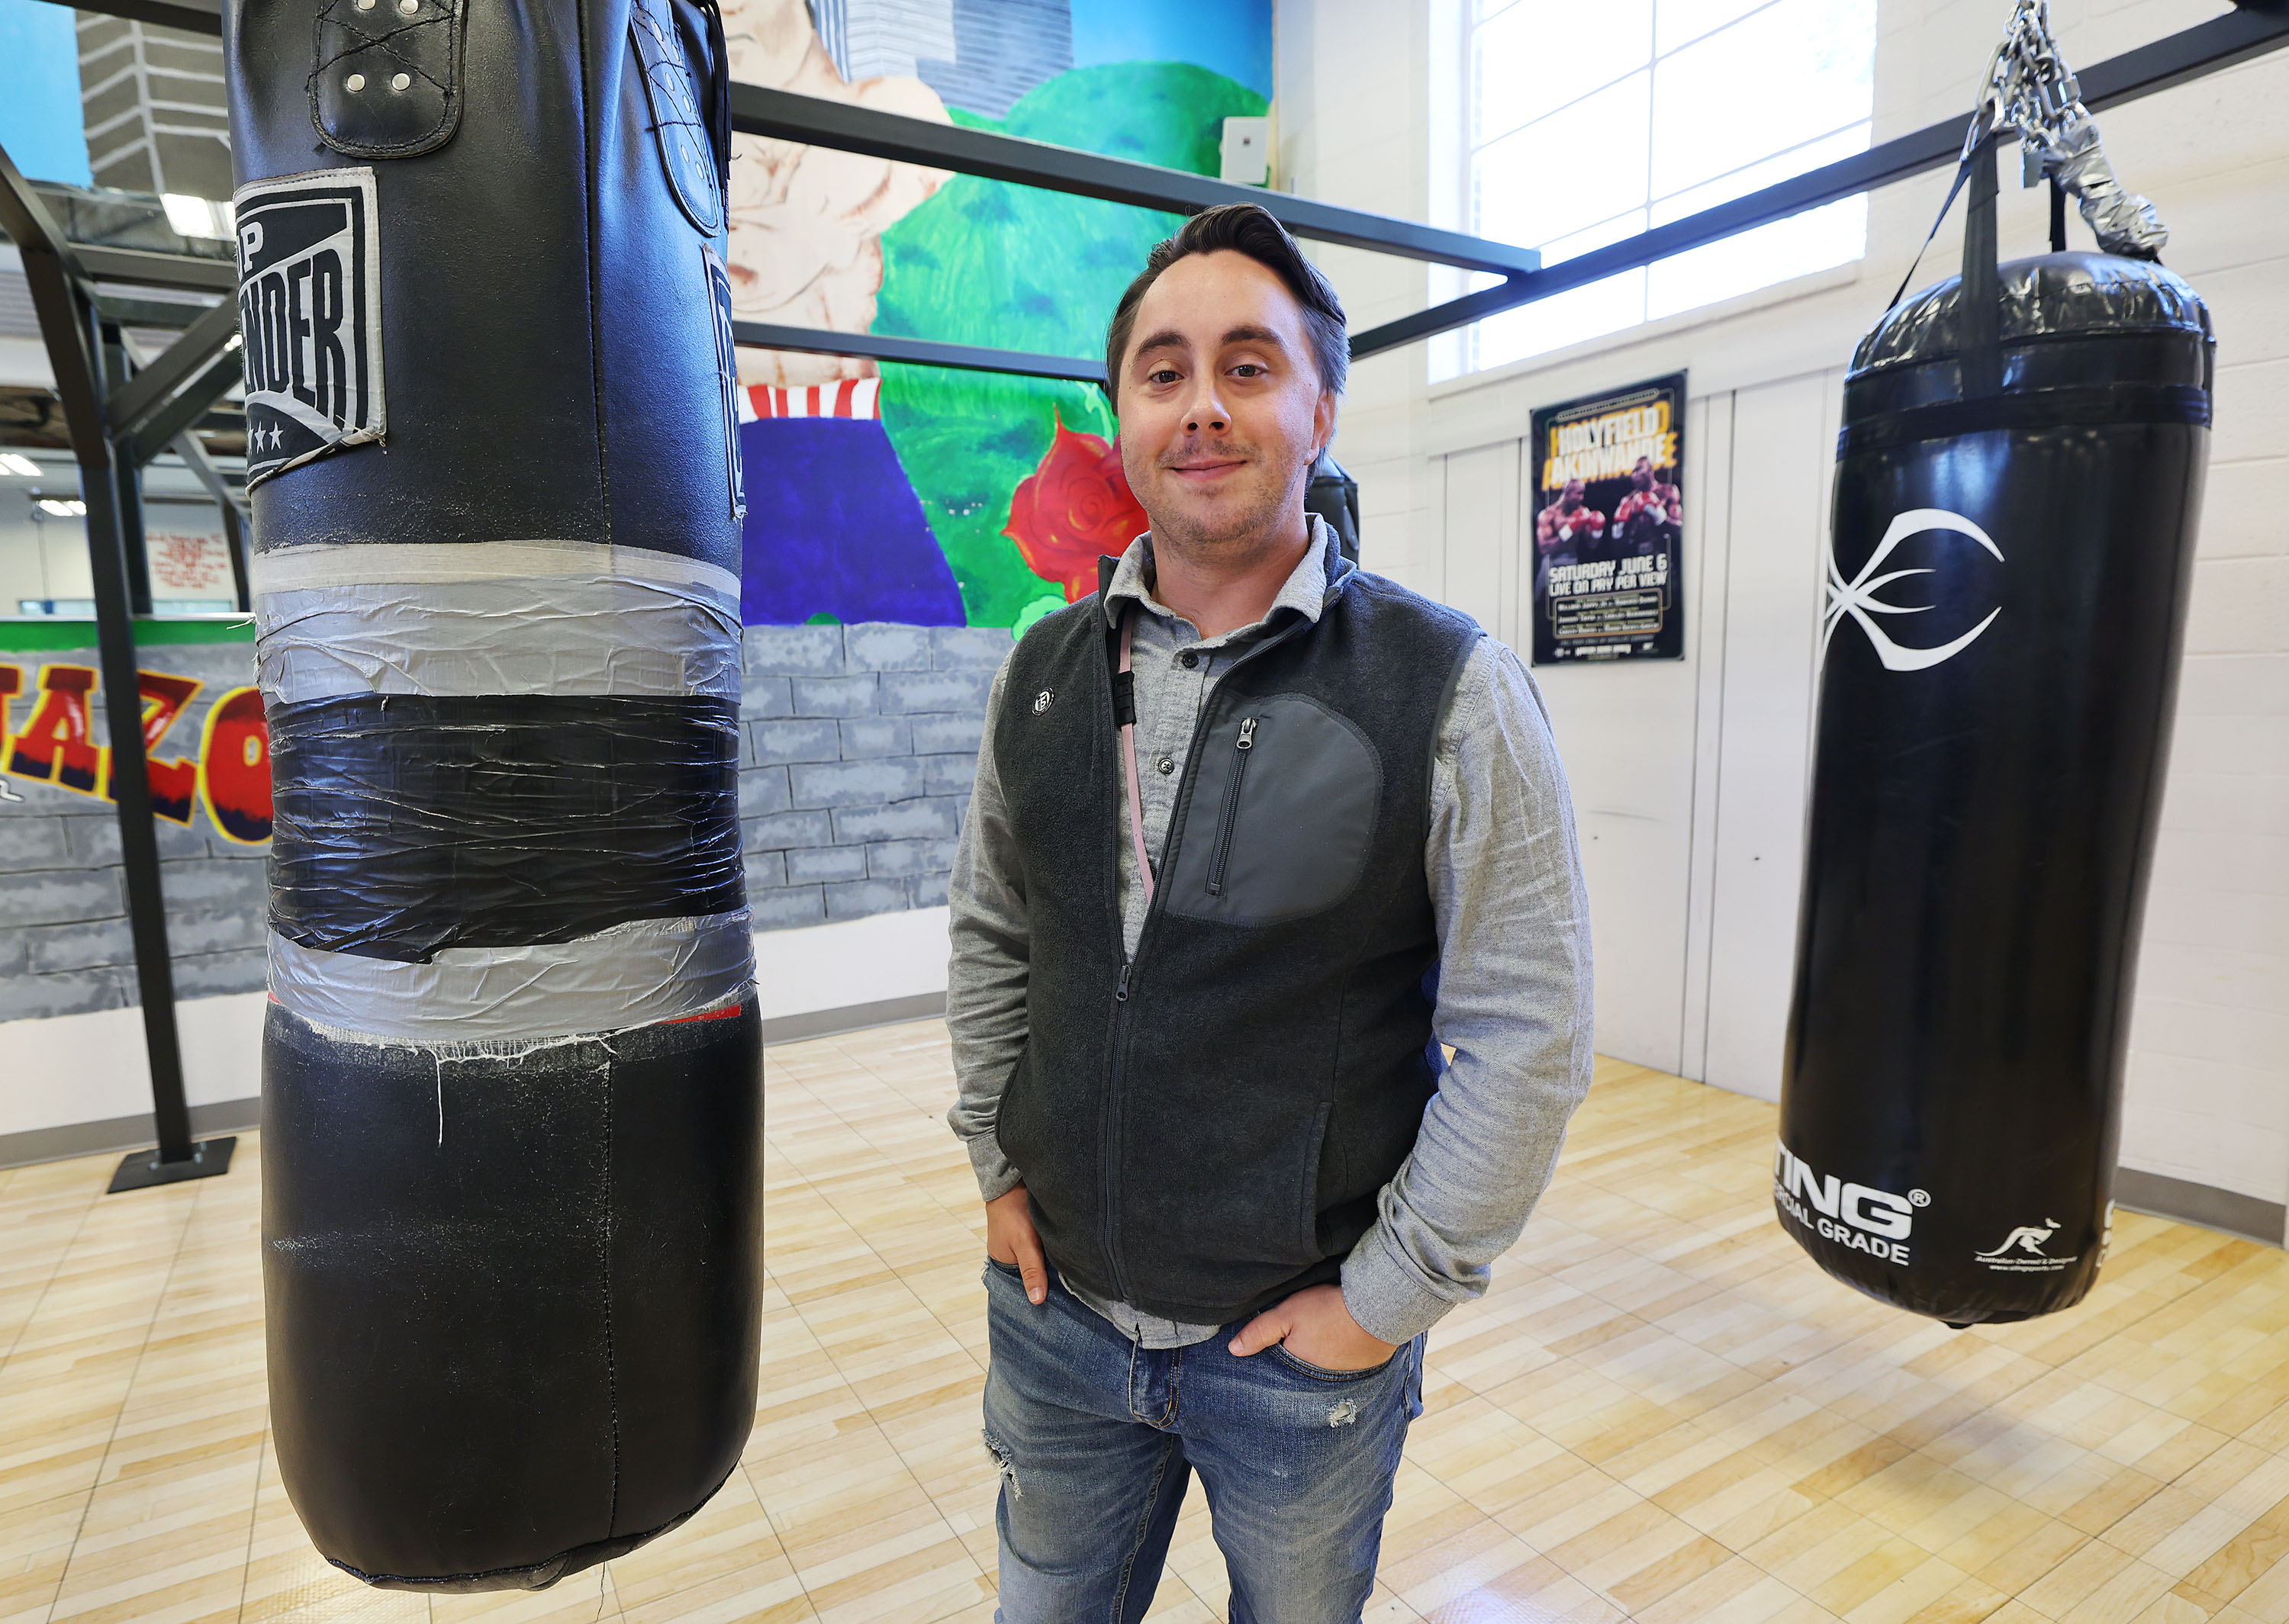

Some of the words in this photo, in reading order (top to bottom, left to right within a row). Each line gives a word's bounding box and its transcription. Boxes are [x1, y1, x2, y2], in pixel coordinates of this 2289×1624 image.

[1553, 403, 1666, 456] HOLYFIELD
[1546, 432, 1672, 488] AKINWANDE
[1549, 560, 1616, 583] SATURDAY
[1618, 555, 1654, 575] JUNE
[1656, 553, 1668, 571] 6
[1549, 580, 1572, 597] LIVE
[1573, 578, 1590, 593] ON
[1591, 577, 1614, 593] PAY
[1615, 574, 1637, 590] PER
[1638, 571, 1668, 587] VIEW
[1817, 1218, 1911, 1266] GRADE
